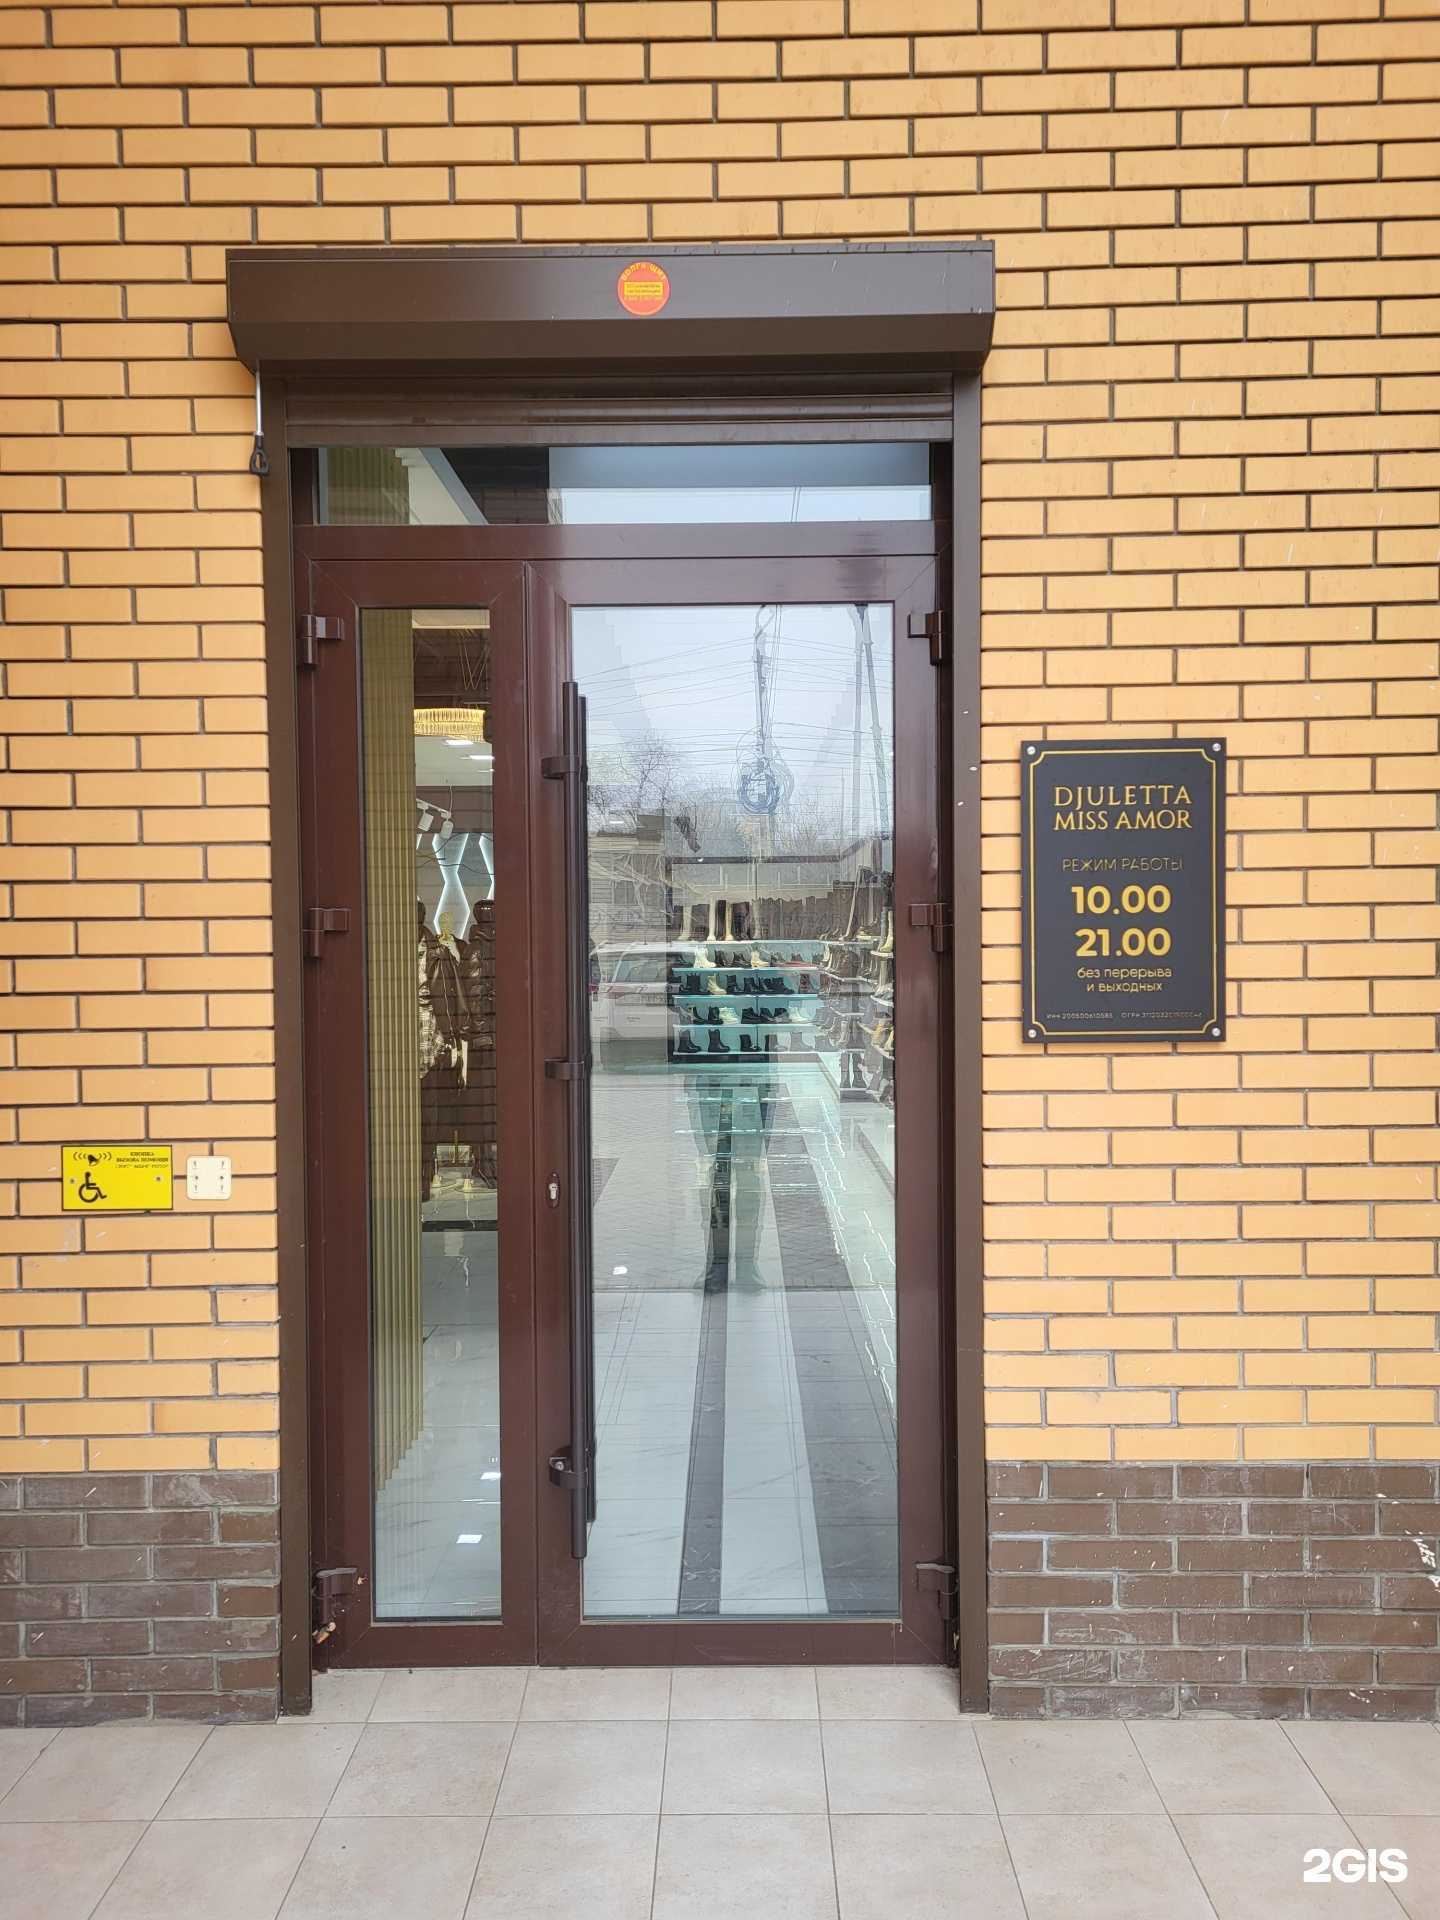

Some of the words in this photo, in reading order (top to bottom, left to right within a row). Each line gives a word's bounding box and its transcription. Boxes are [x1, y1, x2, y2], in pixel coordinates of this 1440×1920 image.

[1054, 785, 1192, 810] DJULETTA
[1054, 810, 1108, 831] MISS
[1115, 809, 1192, 829] AMOR
[1062, 859, 1117, 872] РЕЖИМ
[1121, 857, 1183, 871] РАБОТЫ
[1071, 884, 1171, 915] 10.00
[1074, 927, 1171, 957] 21.00
[1077, 967, 1100, 979] без
[1104, 968, 1172, 980] перерыва
[1087, 983, 1095, 992] и
[1098, 982, 1162, 993] выходных
